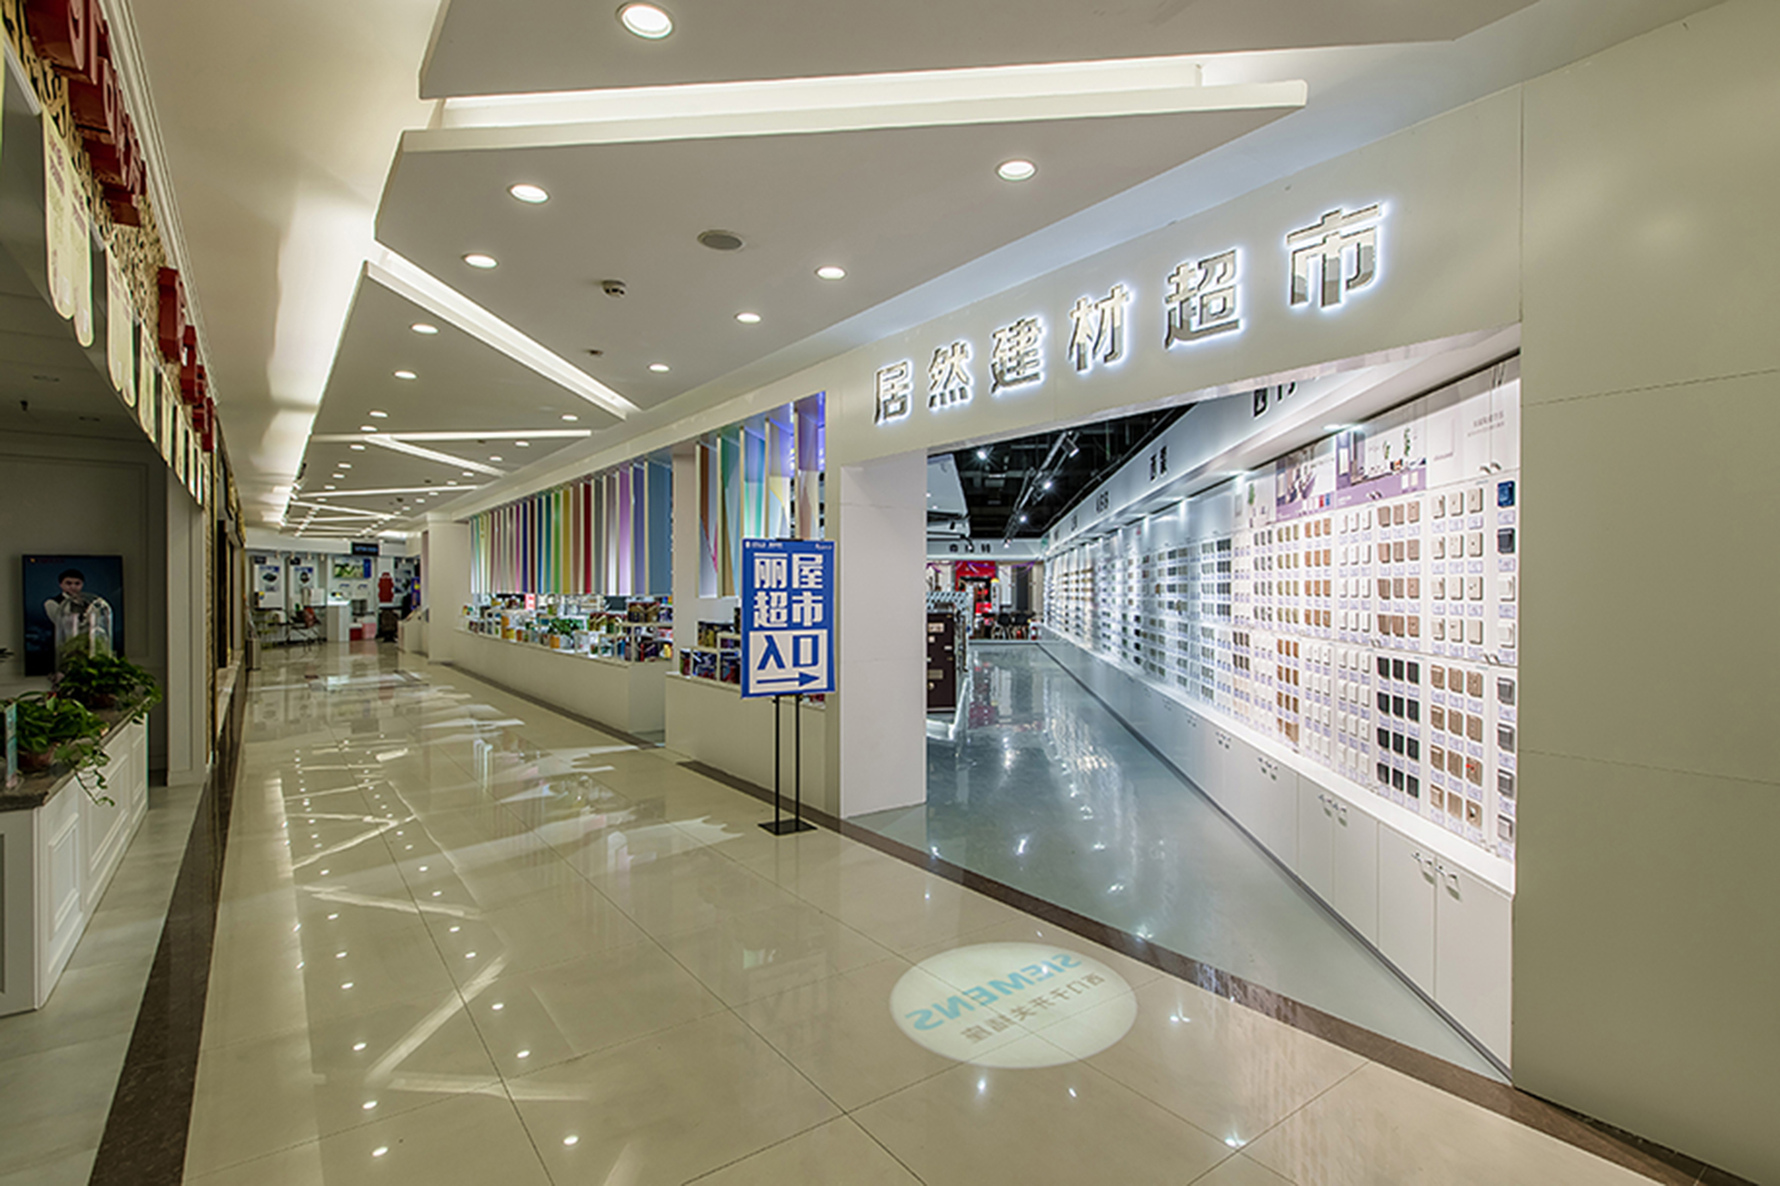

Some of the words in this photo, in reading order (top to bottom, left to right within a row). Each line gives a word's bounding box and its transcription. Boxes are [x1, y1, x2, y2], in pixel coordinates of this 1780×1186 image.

[873, 201, 1385, 426] 居然建材超市
[753, 552, 824, 589] 丽屋
[753, 591, 824, 629] 超市
[756, 634, 820, 671] 入口
